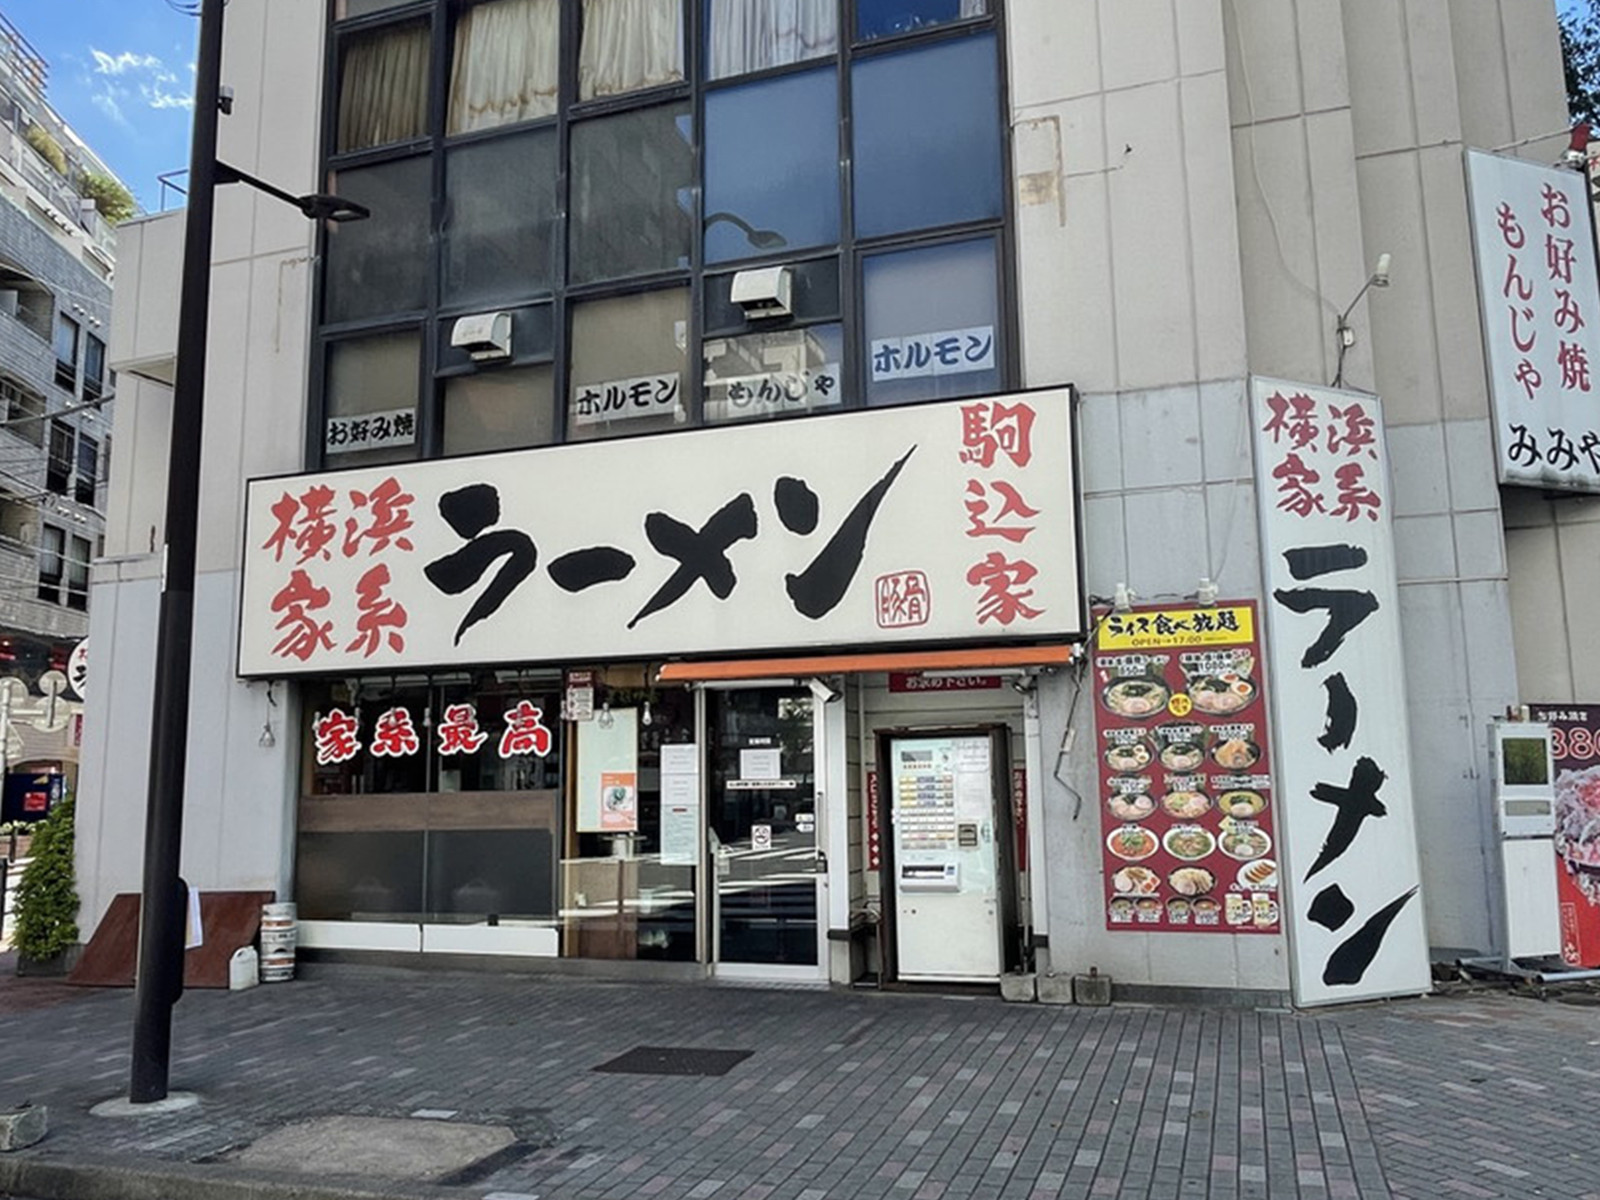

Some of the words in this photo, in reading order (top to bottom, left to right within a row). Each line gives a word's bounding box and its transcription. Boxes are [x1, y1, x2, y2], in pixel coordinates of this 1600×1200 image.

[1496, 201, 1542, 400] もんじゃ
[1541, 182, 1591, 393] お好み焼
[874, 333, 992, 373] ホルモン
[327, 415, 415, 446] お好み焼
[577, 379, 677, 416] ホルモン
[1262, 391, 1378, 460] 横浜
[262, 477, 415, 565] 横浜
[958, 400, 1046, 626] 駒込家
[1272, 453, 1381, 522] 家系
[423, 444, 918, 647] ラーメン
[271, 563, 408, 662] 家系
[1107, 610, 1240, 637] ライス食べ放題
[316, 701, 552, 765] 家系最高
[1273, 543, 1420, 986] ラーメン
